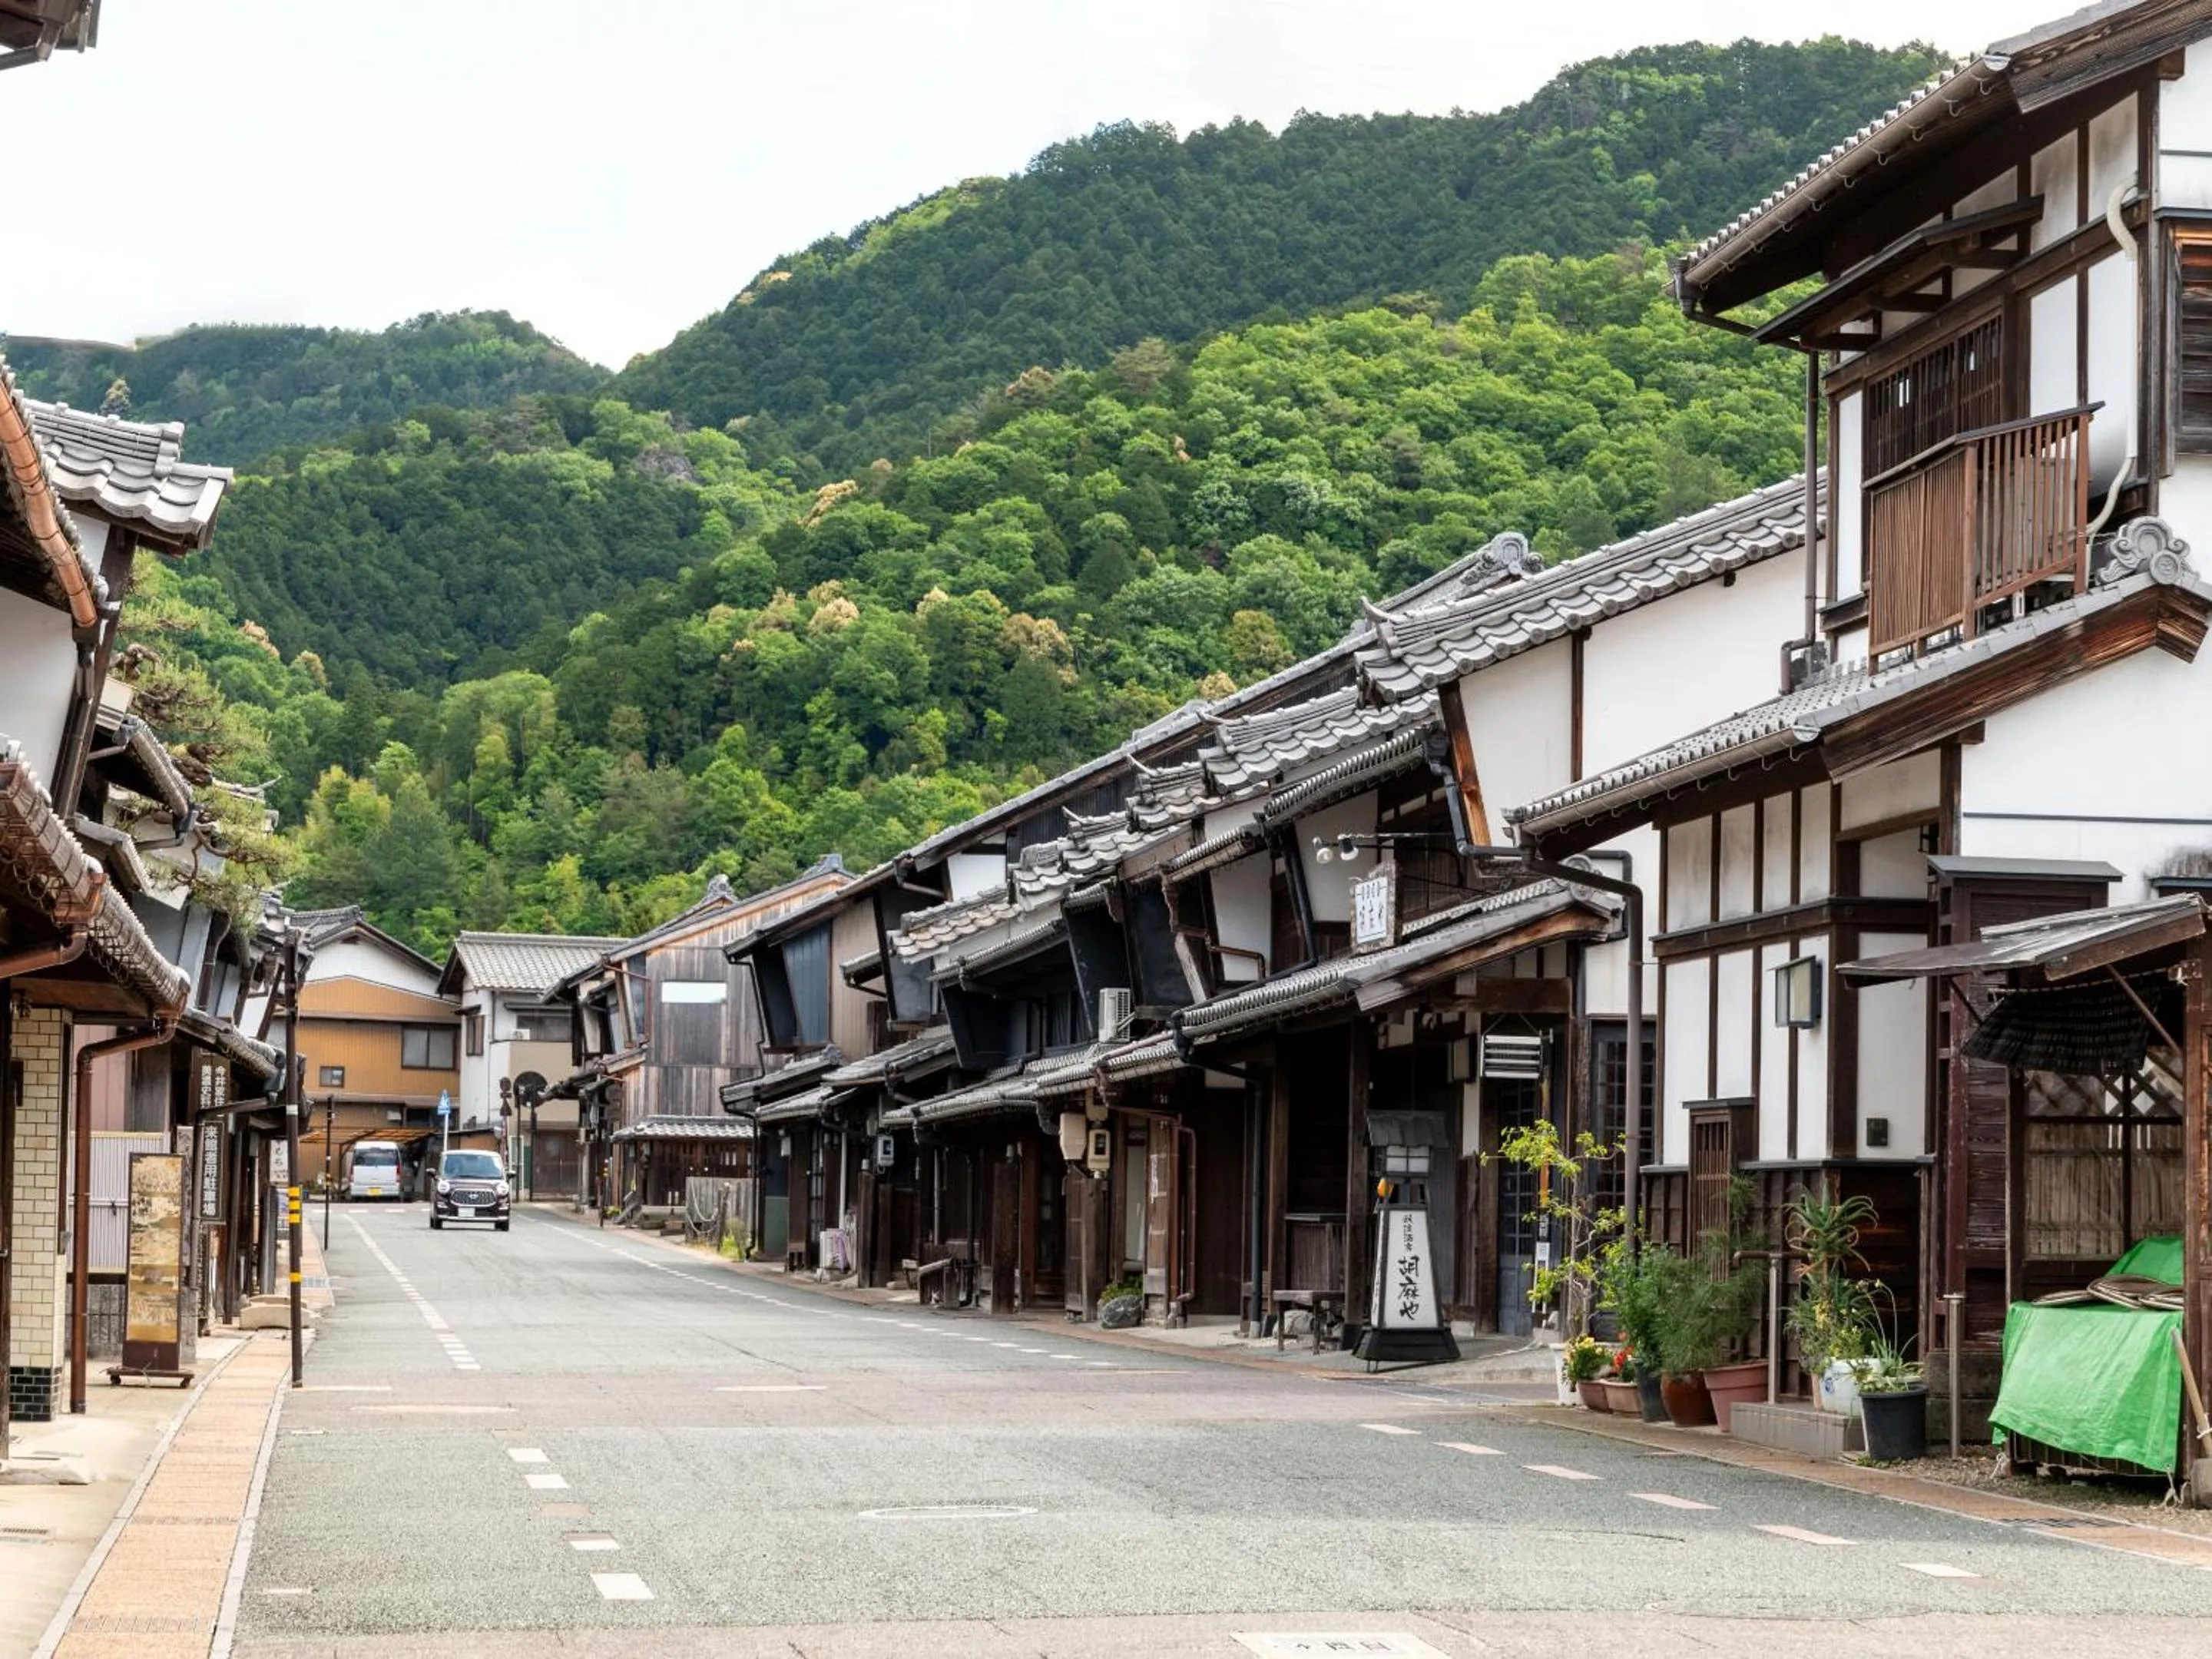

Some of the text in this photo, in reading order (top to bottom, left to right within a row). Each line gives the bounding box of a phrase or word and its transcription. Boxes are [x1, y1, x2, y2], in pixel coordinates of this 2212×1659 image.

[200, 1065, 212, 1109] 美濃史料
[215, 1065, 227, 1108] 今井家住
[202, 1124, 218, 1216] 来館者用駐車場
[1397, 1254, 1420, 1321] 胡麻や
